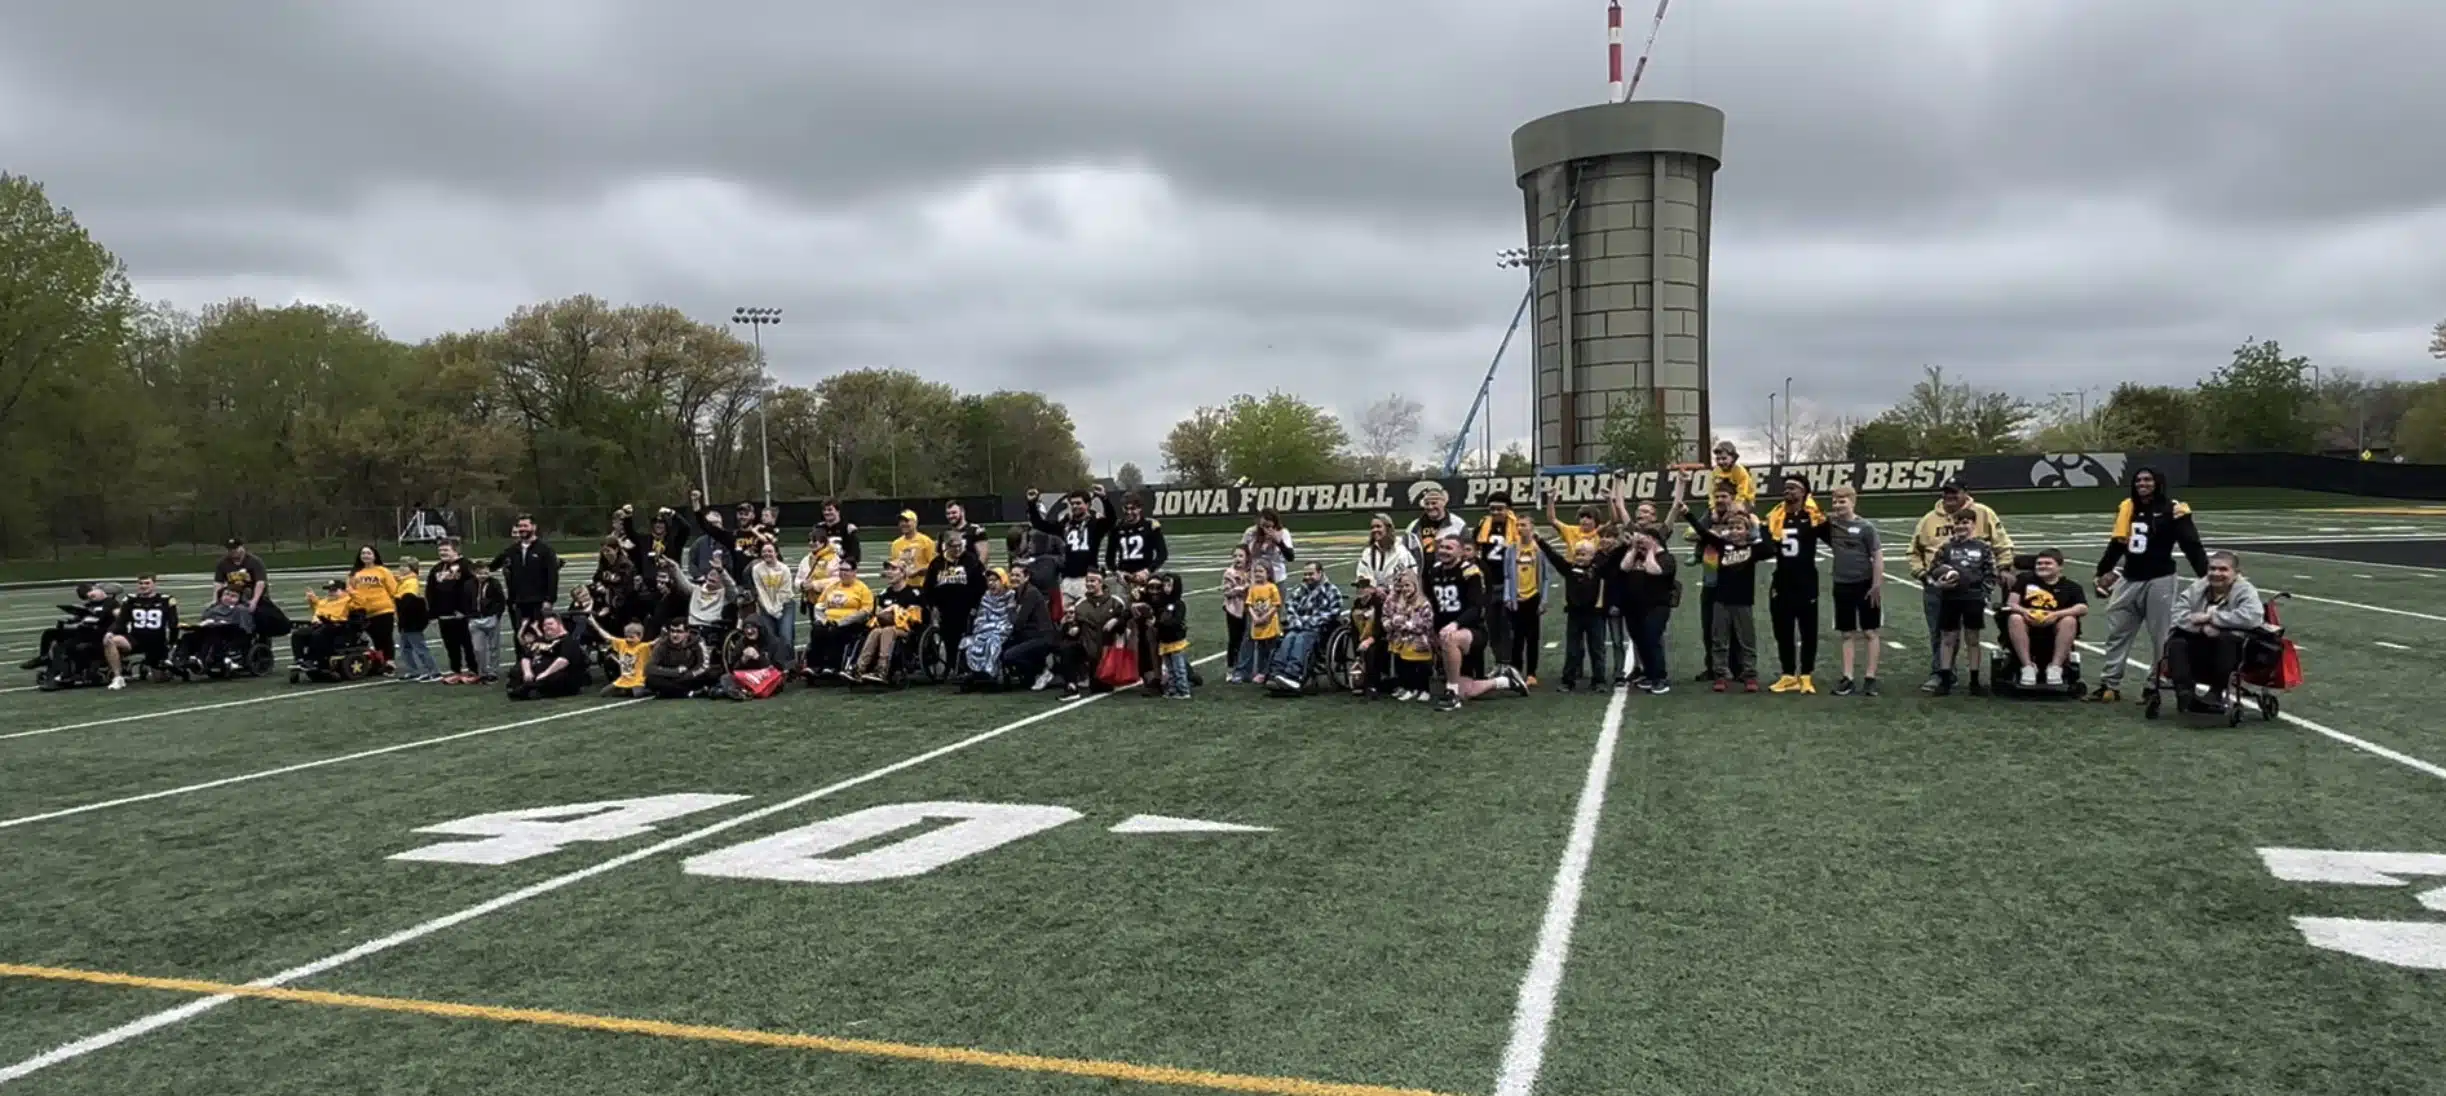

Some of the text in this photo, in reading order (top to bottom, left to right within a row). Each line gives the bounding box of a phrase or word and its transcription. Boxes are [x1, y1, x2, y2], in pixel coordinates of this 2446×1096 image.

[1862, 460, 1964, 489] BEST
[1152, 483, 1393, 516] IOWA FOOTBALL
[1067, 529, 1090, 551] 41
[1120, 535, 1144, 560] 12
[1487, 535, 1505, 560] 2
[1781, 528, 1799, 556] 5
[2129, 522, 2148, 553] 6
[132, 609, 162, 628] 99
